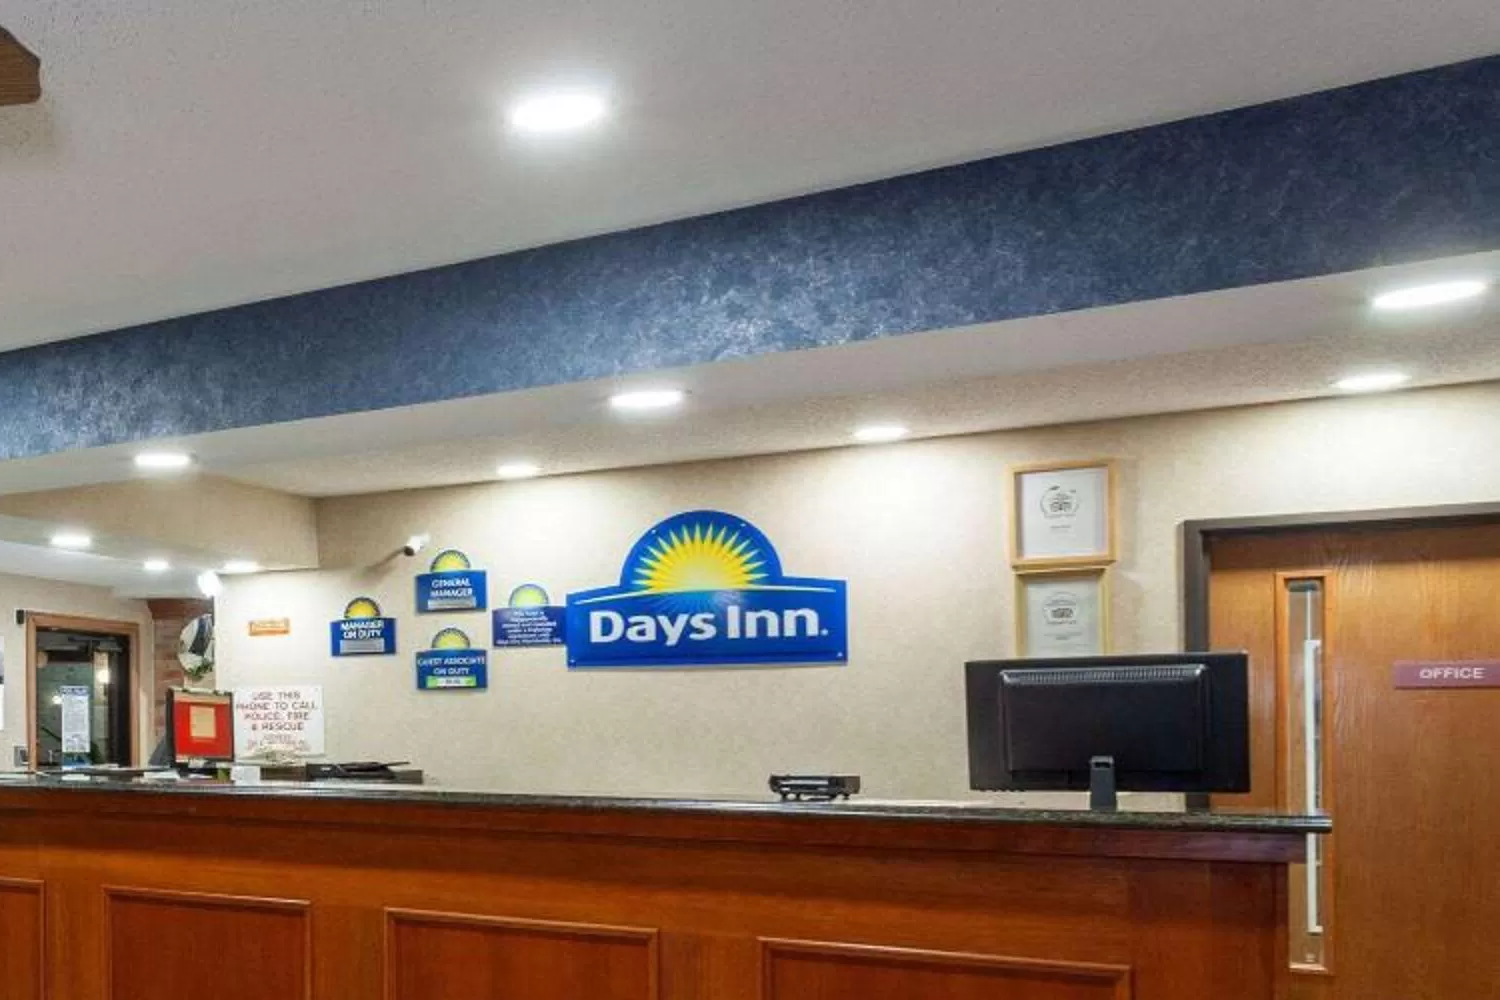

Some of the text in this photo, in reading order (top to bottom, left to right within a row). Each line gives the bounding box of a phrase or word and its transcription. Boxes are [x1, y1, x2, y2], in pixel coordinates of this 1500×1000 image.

[431, 578, 471, 588] GENERAL
[429, 587, 473, 597] MANAGER
[341, 619, 384, 630] MANAGER
[589, 610, 717, 646] Days
[343, 628, 381, 639] ON DUTY
[433, 666, 470, 675] ON DUTY
[1419, 667, 1486, 679] OFFICE
[276, 690, 300, 700] THIS
[274, 701, 289, 710] TO
[291, 700, 317, 710] CALL
[287, 711, 310, 720] FIRE
[261, 721, 305, 731] RESCUE
